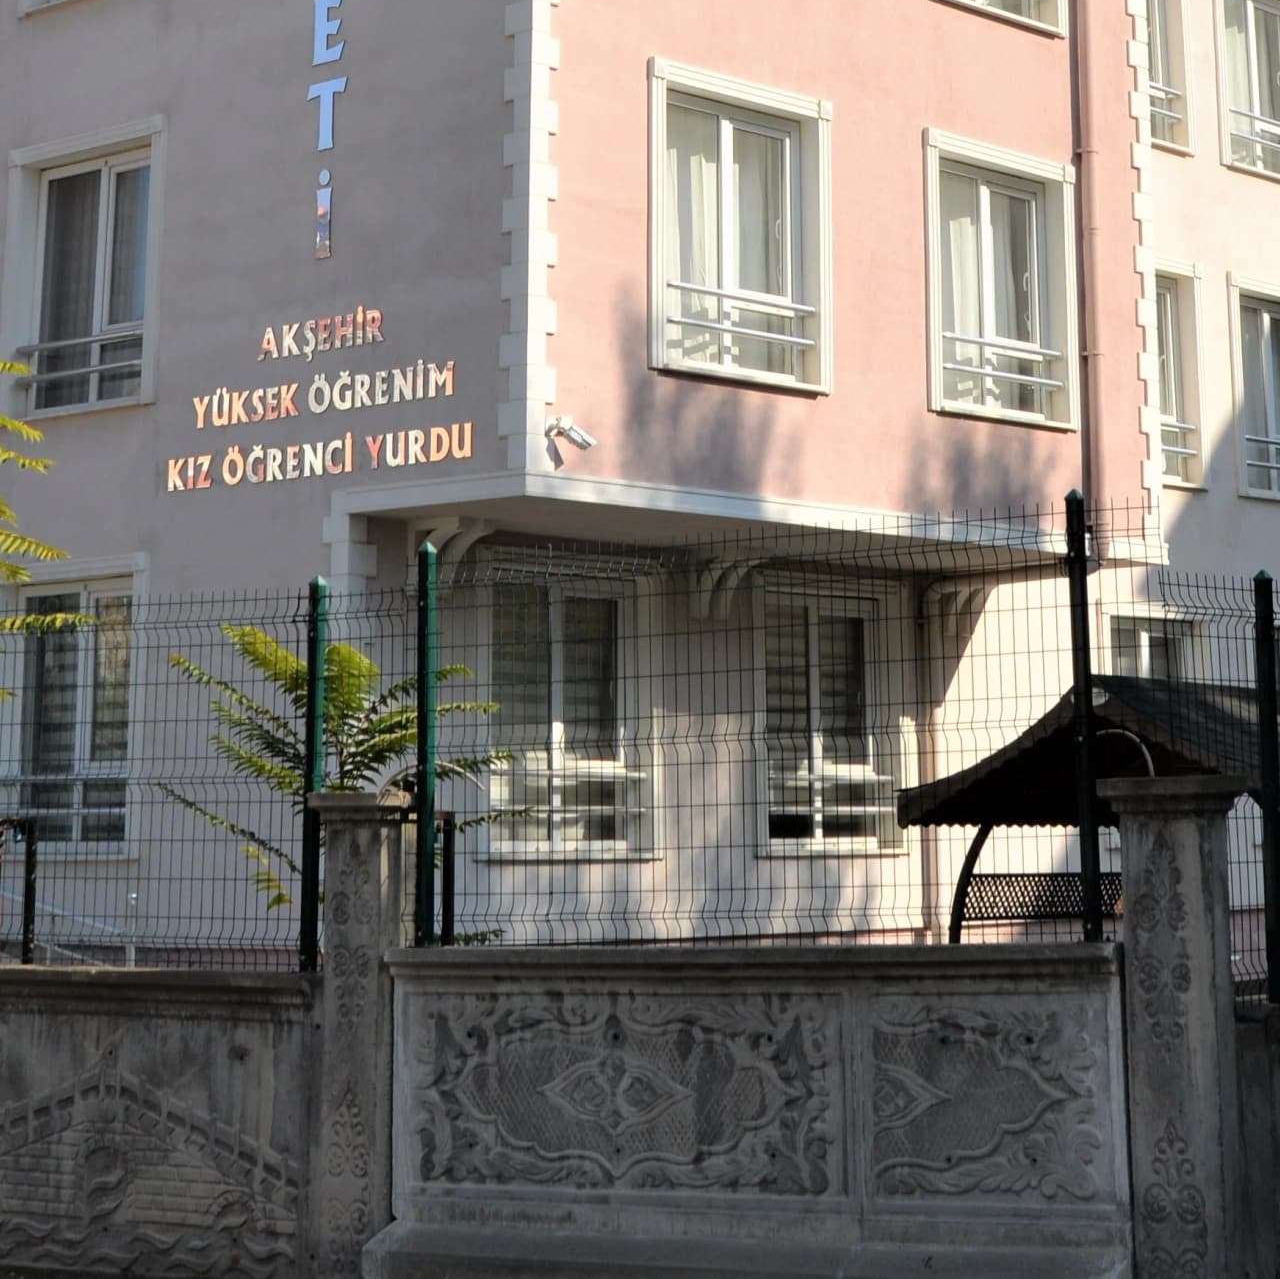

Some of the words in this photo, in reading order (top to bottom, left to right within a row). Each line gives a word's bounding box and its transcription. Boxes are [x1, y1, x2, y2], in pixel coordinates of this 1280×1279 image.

[257, 305, 385, 362] AKŞEHİR
[193, 383, 299, 429] YÜKSEK
[308, 359, 455, 415] ÖĞRENİM
[167, 451, 213, 492] KIZ
[222, 432, 353, 486] ÖĞRENCİ
[365, 421, 473, 470] YURDU
